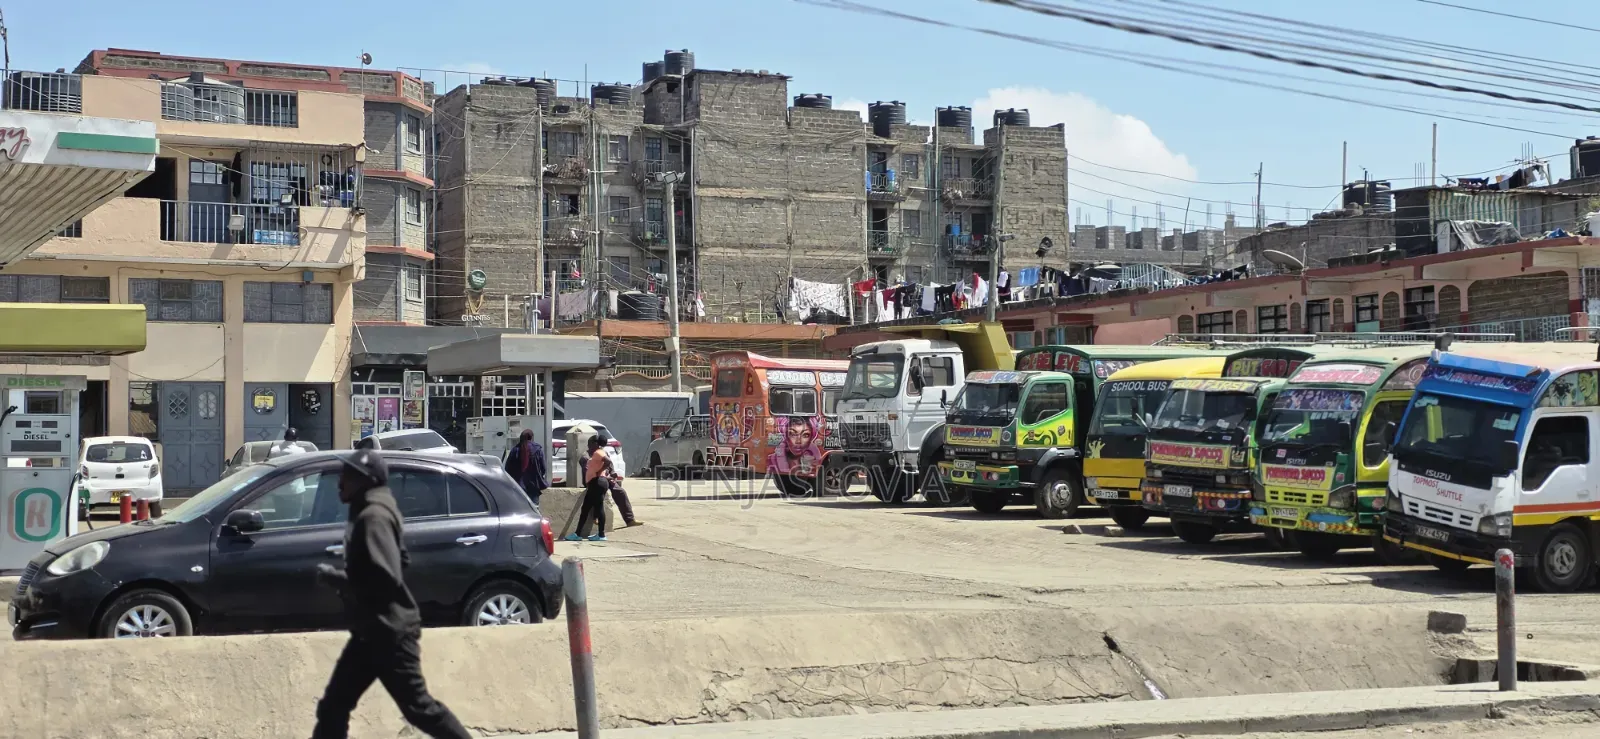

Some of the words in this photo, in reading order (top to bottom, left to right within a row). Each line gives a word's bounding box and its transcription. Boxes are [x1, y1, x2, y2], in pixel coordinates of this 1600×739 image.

[7, 377, 65, 387] DIESEL
[1111, 381, 1146, 392] SCHOOL
[1148, 381, 1168, 391] BUS
[1425, 469, 1451, 481] ISUZU
[1413, 476, 1439, 489] TOPMOST
[1436, 487, 1463, 502] SHUTTLE
